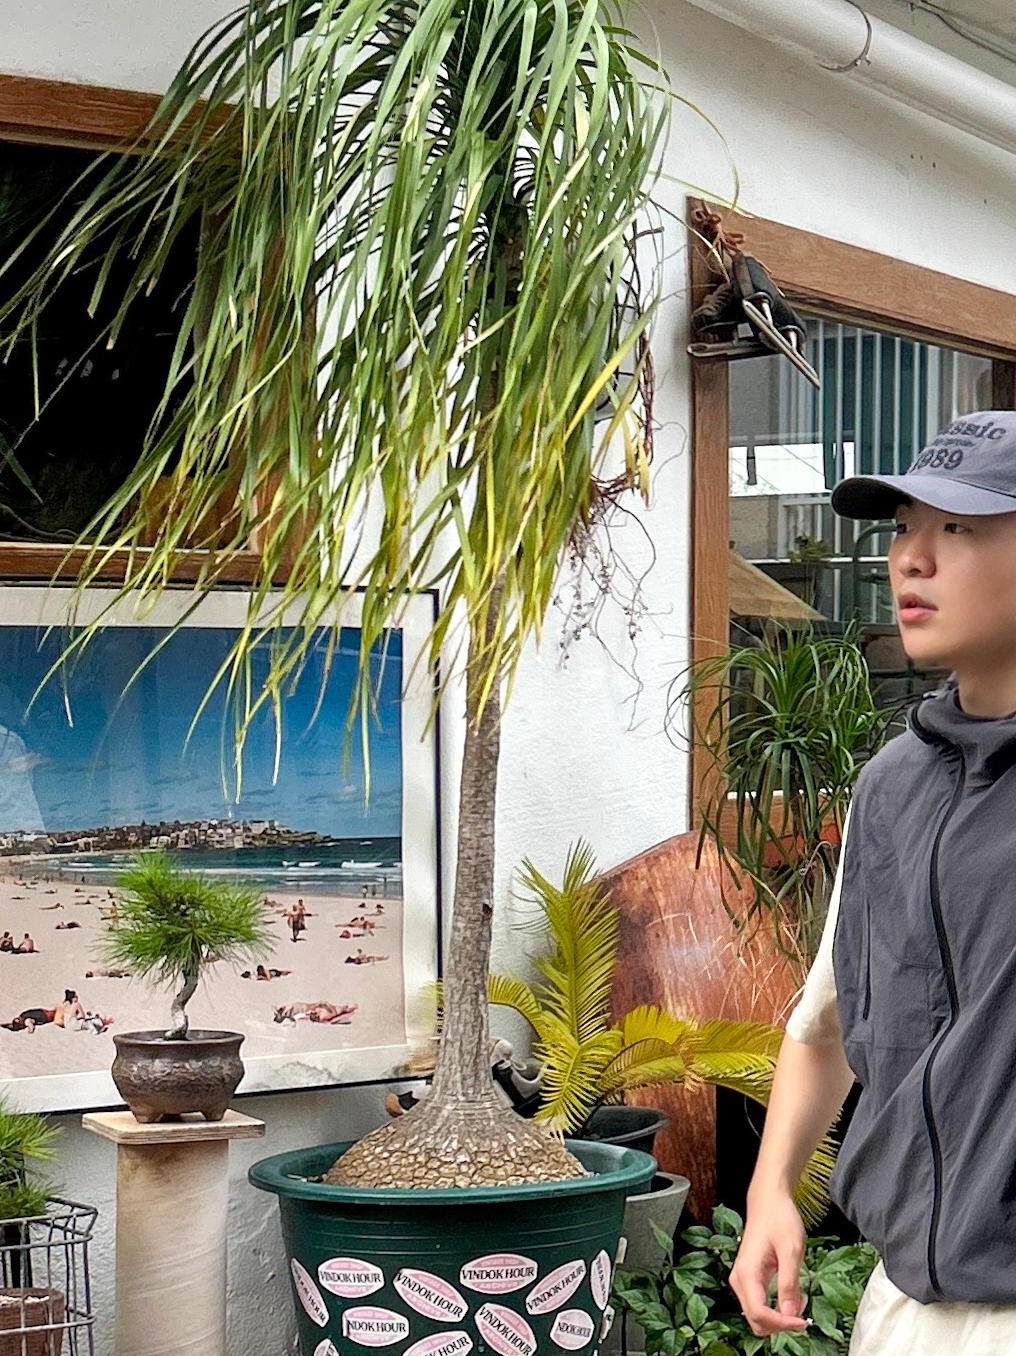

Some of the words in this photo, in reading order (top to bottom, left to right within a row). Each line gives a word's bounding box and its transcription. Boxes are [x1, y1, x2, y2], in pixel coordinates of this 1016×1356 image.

[353, 1272, 381, 1283] HOUR
[463, 1269, 504, 1280] VINDOK
[505, 1267, 534, 1279] HOUR
[562, 1266, 584, 1289] HOUR
[397, 1273, 433, 1301] VINDOK
[433, 1295, 463, 1317] HOUR
[376, 1321, 406, 1333] HOUR
[479, 1307, 511, 1338] VINDOK
[508, 1332, 532, 1356] HOUR
